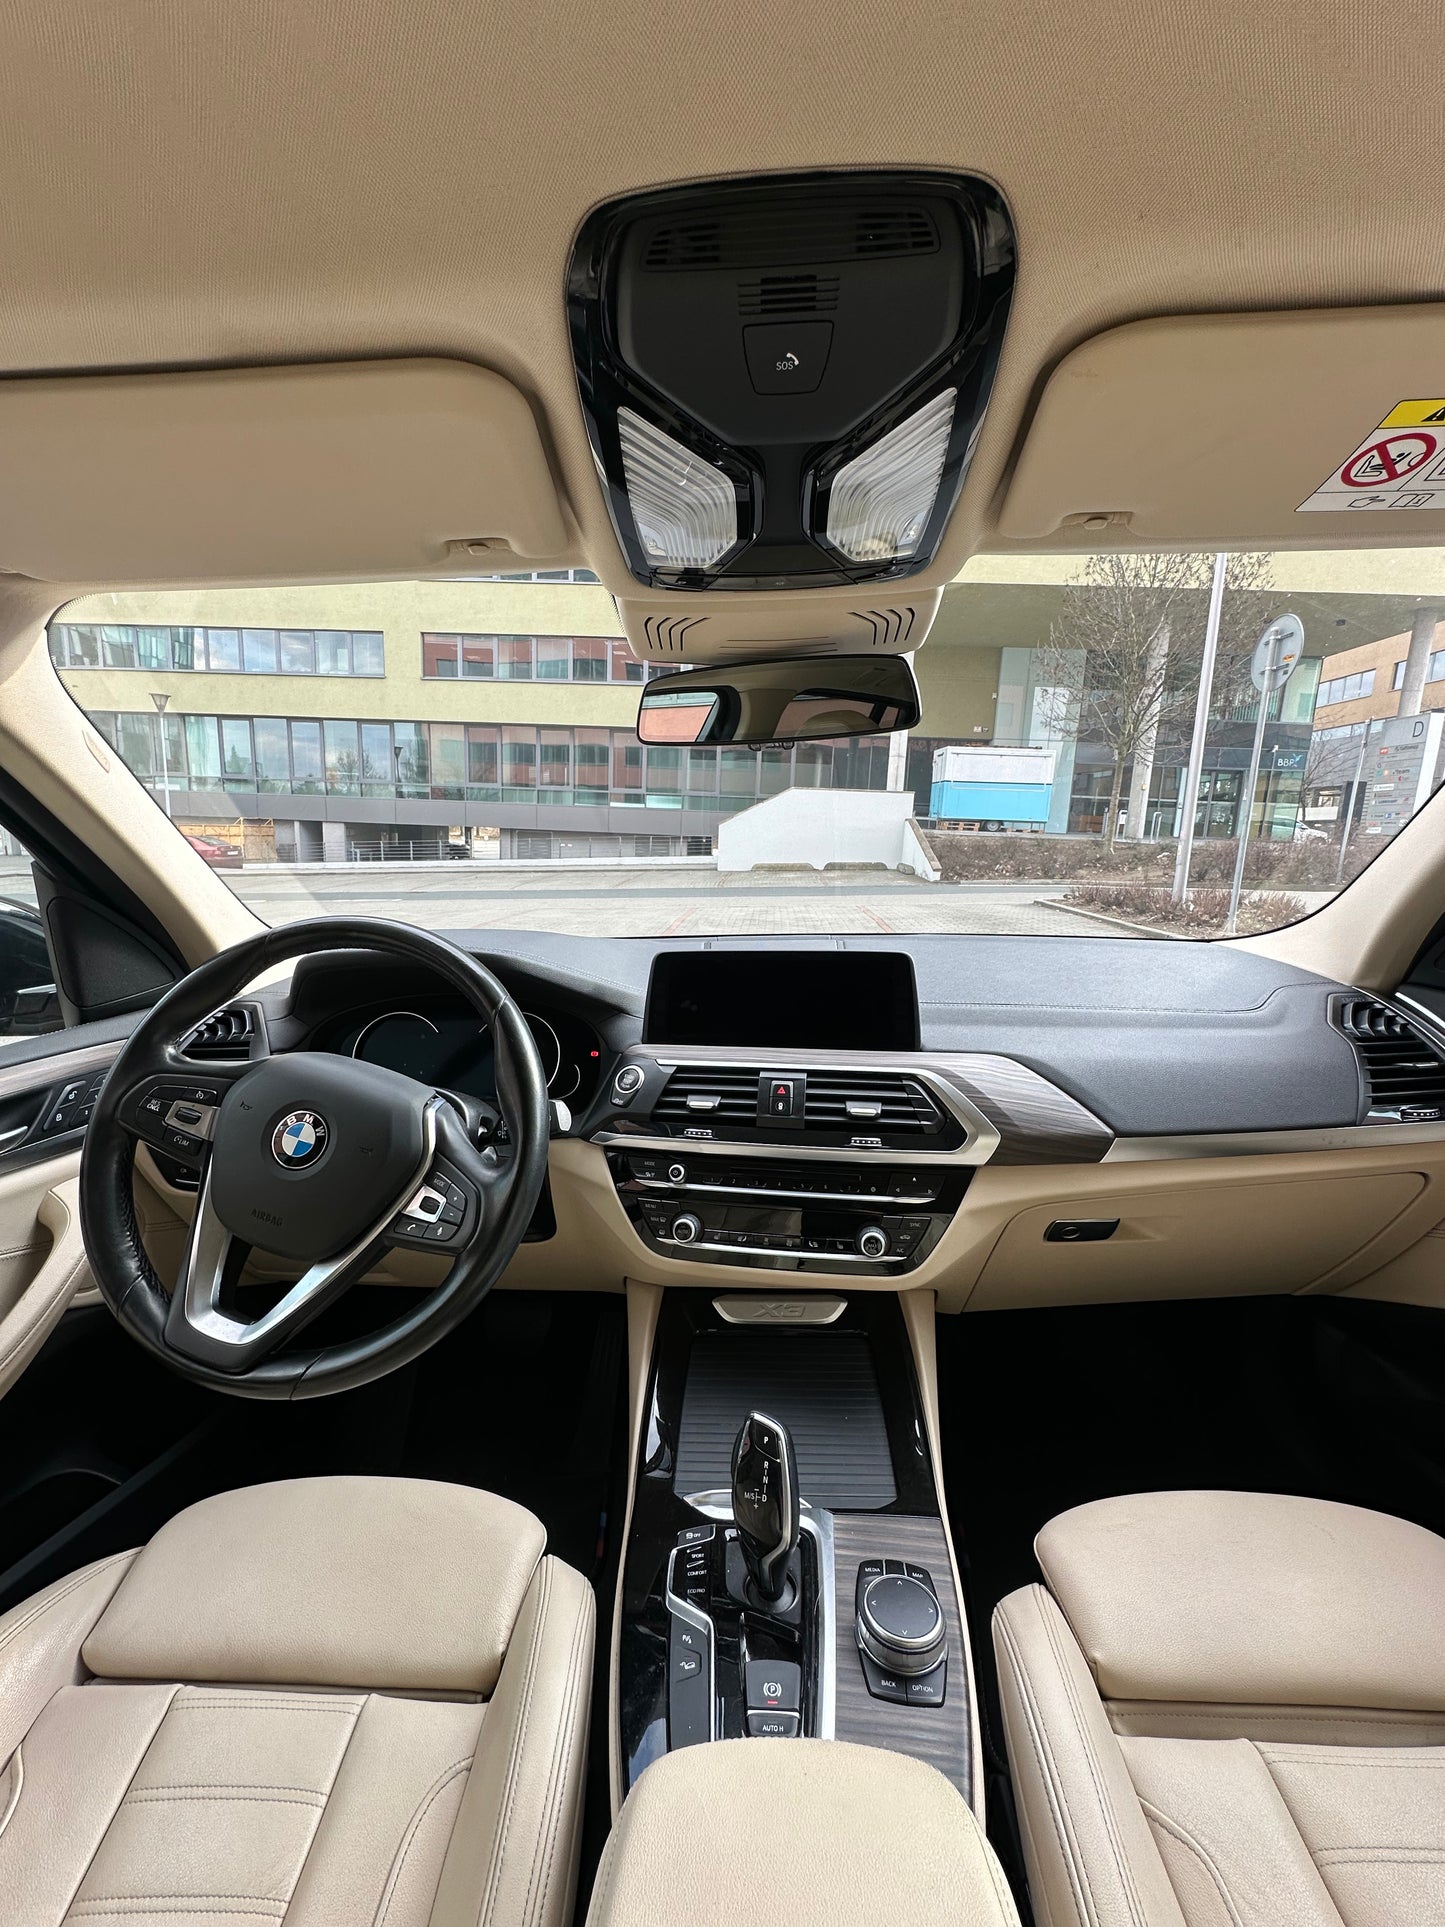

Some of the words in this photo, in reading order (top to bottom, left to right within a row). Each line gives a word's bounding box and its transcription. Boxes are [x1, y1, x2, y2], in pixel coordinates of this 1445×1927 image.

[776, 361, 794, 371] SOS
[1412, 721, 1425, 738] D
[286, 1113, 326, 1137] BMW
[250, 1208, 284, 1227] AIRBAG
[752, 1303, 806, 1318] X3
[763, 1436, 769, 1444] P
[763, 1461, 769, 1469] R
[763, 1476, 769, 1484] N
[761, 1494, 768, 1502] D
[881, 1679, 896, 1688] BACK
[911, 1684, 934, 1693] OPTION
[762, 1724, 778, 1732] AUTO
